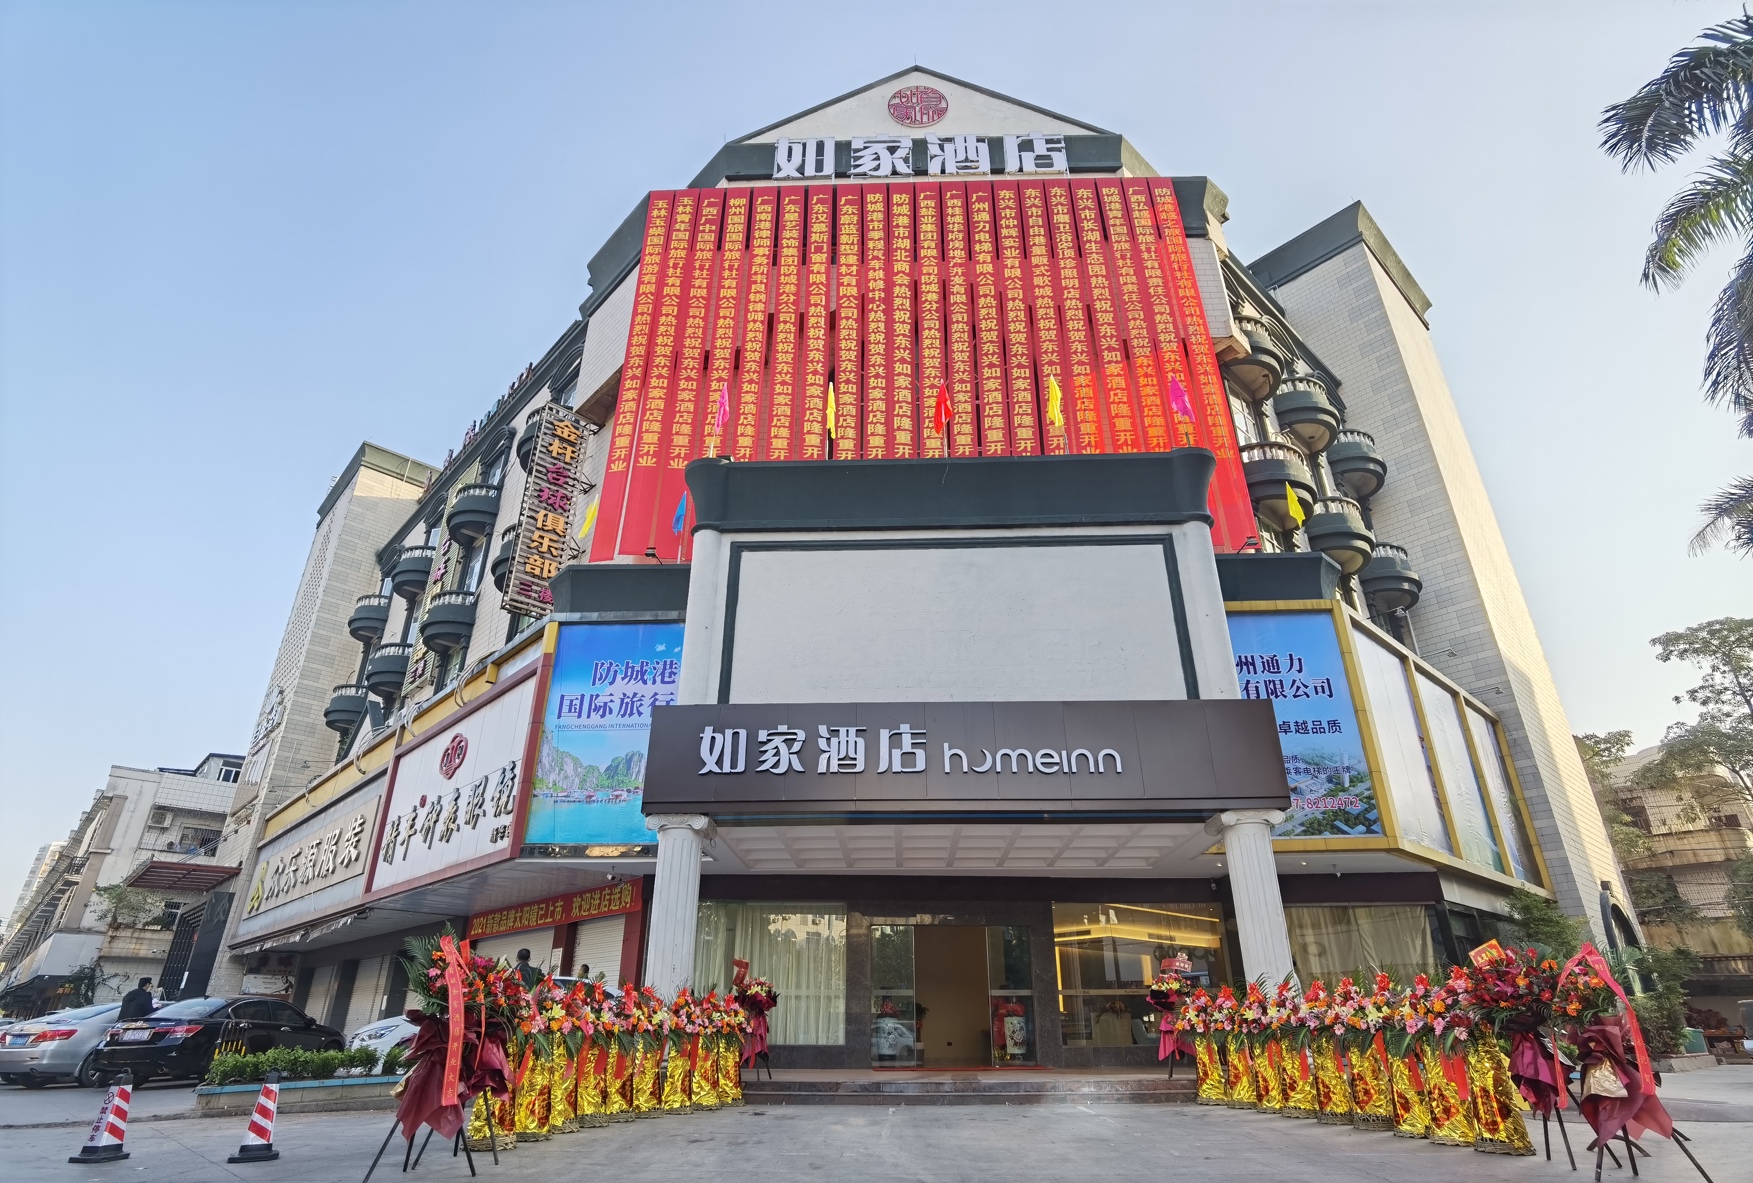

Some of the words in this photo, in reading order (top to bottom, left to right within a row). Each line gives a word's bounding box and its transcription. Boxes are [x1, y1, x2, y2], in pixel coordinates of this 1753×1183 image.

[773, 131, 1068, 178] 如家酒店
[637, 197, 694, 467] 玉林青年国际旅行社有限公司热烈祝贺东兴如家酒店隆重开业
[524, 419, 581, 579] 金杆台球俱乐部
[591, 660, 680, 686] 防城港
[1235, 653, 1304, 676] 州通力
[1240, 677, 1334, 700] 有限公司
[1278, 719, 1343, 735] 卓越品质
[698, 723, 927, 776] 如家酒店
[943, 742, 1123, 775] homeinn
[264, 814, 366, 901] 众乐源服装
[88, 1106, 109, 1142] 禁止停车
